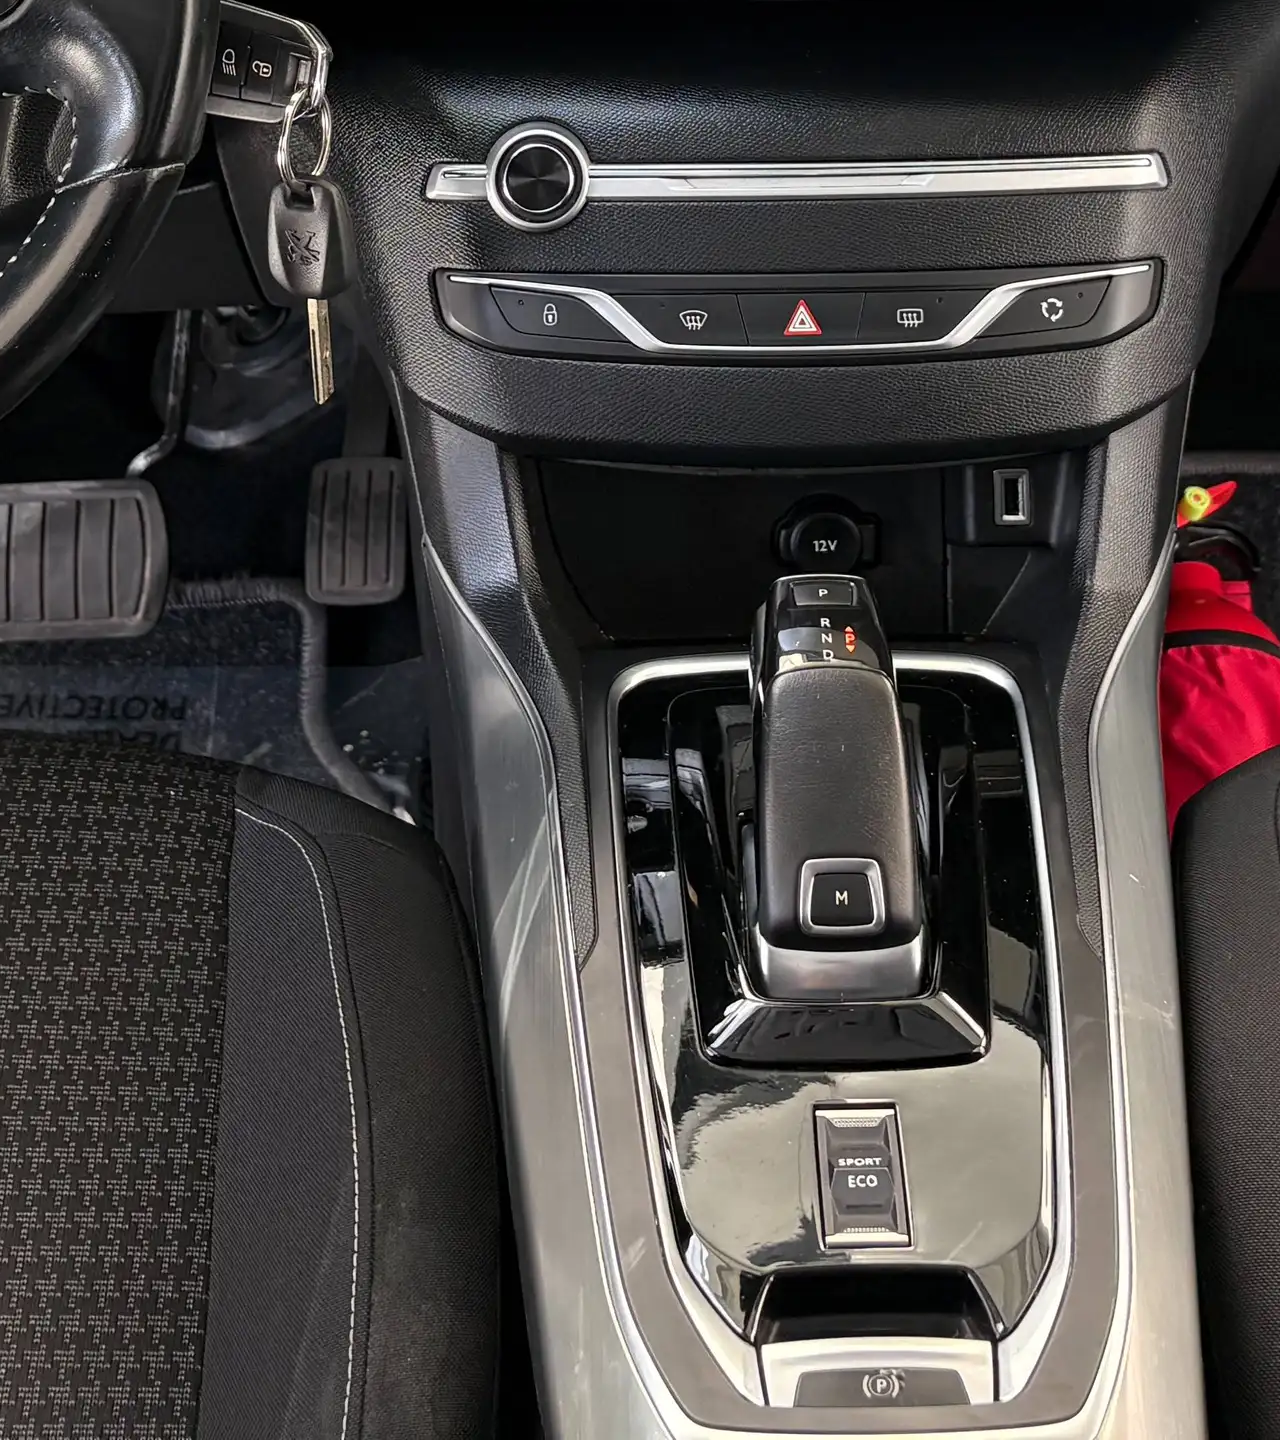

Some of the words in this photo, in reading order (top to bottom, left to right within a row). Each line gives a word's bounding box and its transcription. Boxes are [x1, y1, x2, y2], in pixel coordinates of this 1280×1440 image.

[812, 540, 838, 552] 12V
[818, 588, 828, 597] P
[820, 618, 831, 627] R
[821, 633, 832, 643] N
[845, 633, 855, 643] P
[822, 649, 834, 660] D
[835, 891, 848, 905] M
[838, 1157, 882, 1167] SPORT
[847, 1175, 878, 1188] ECO
